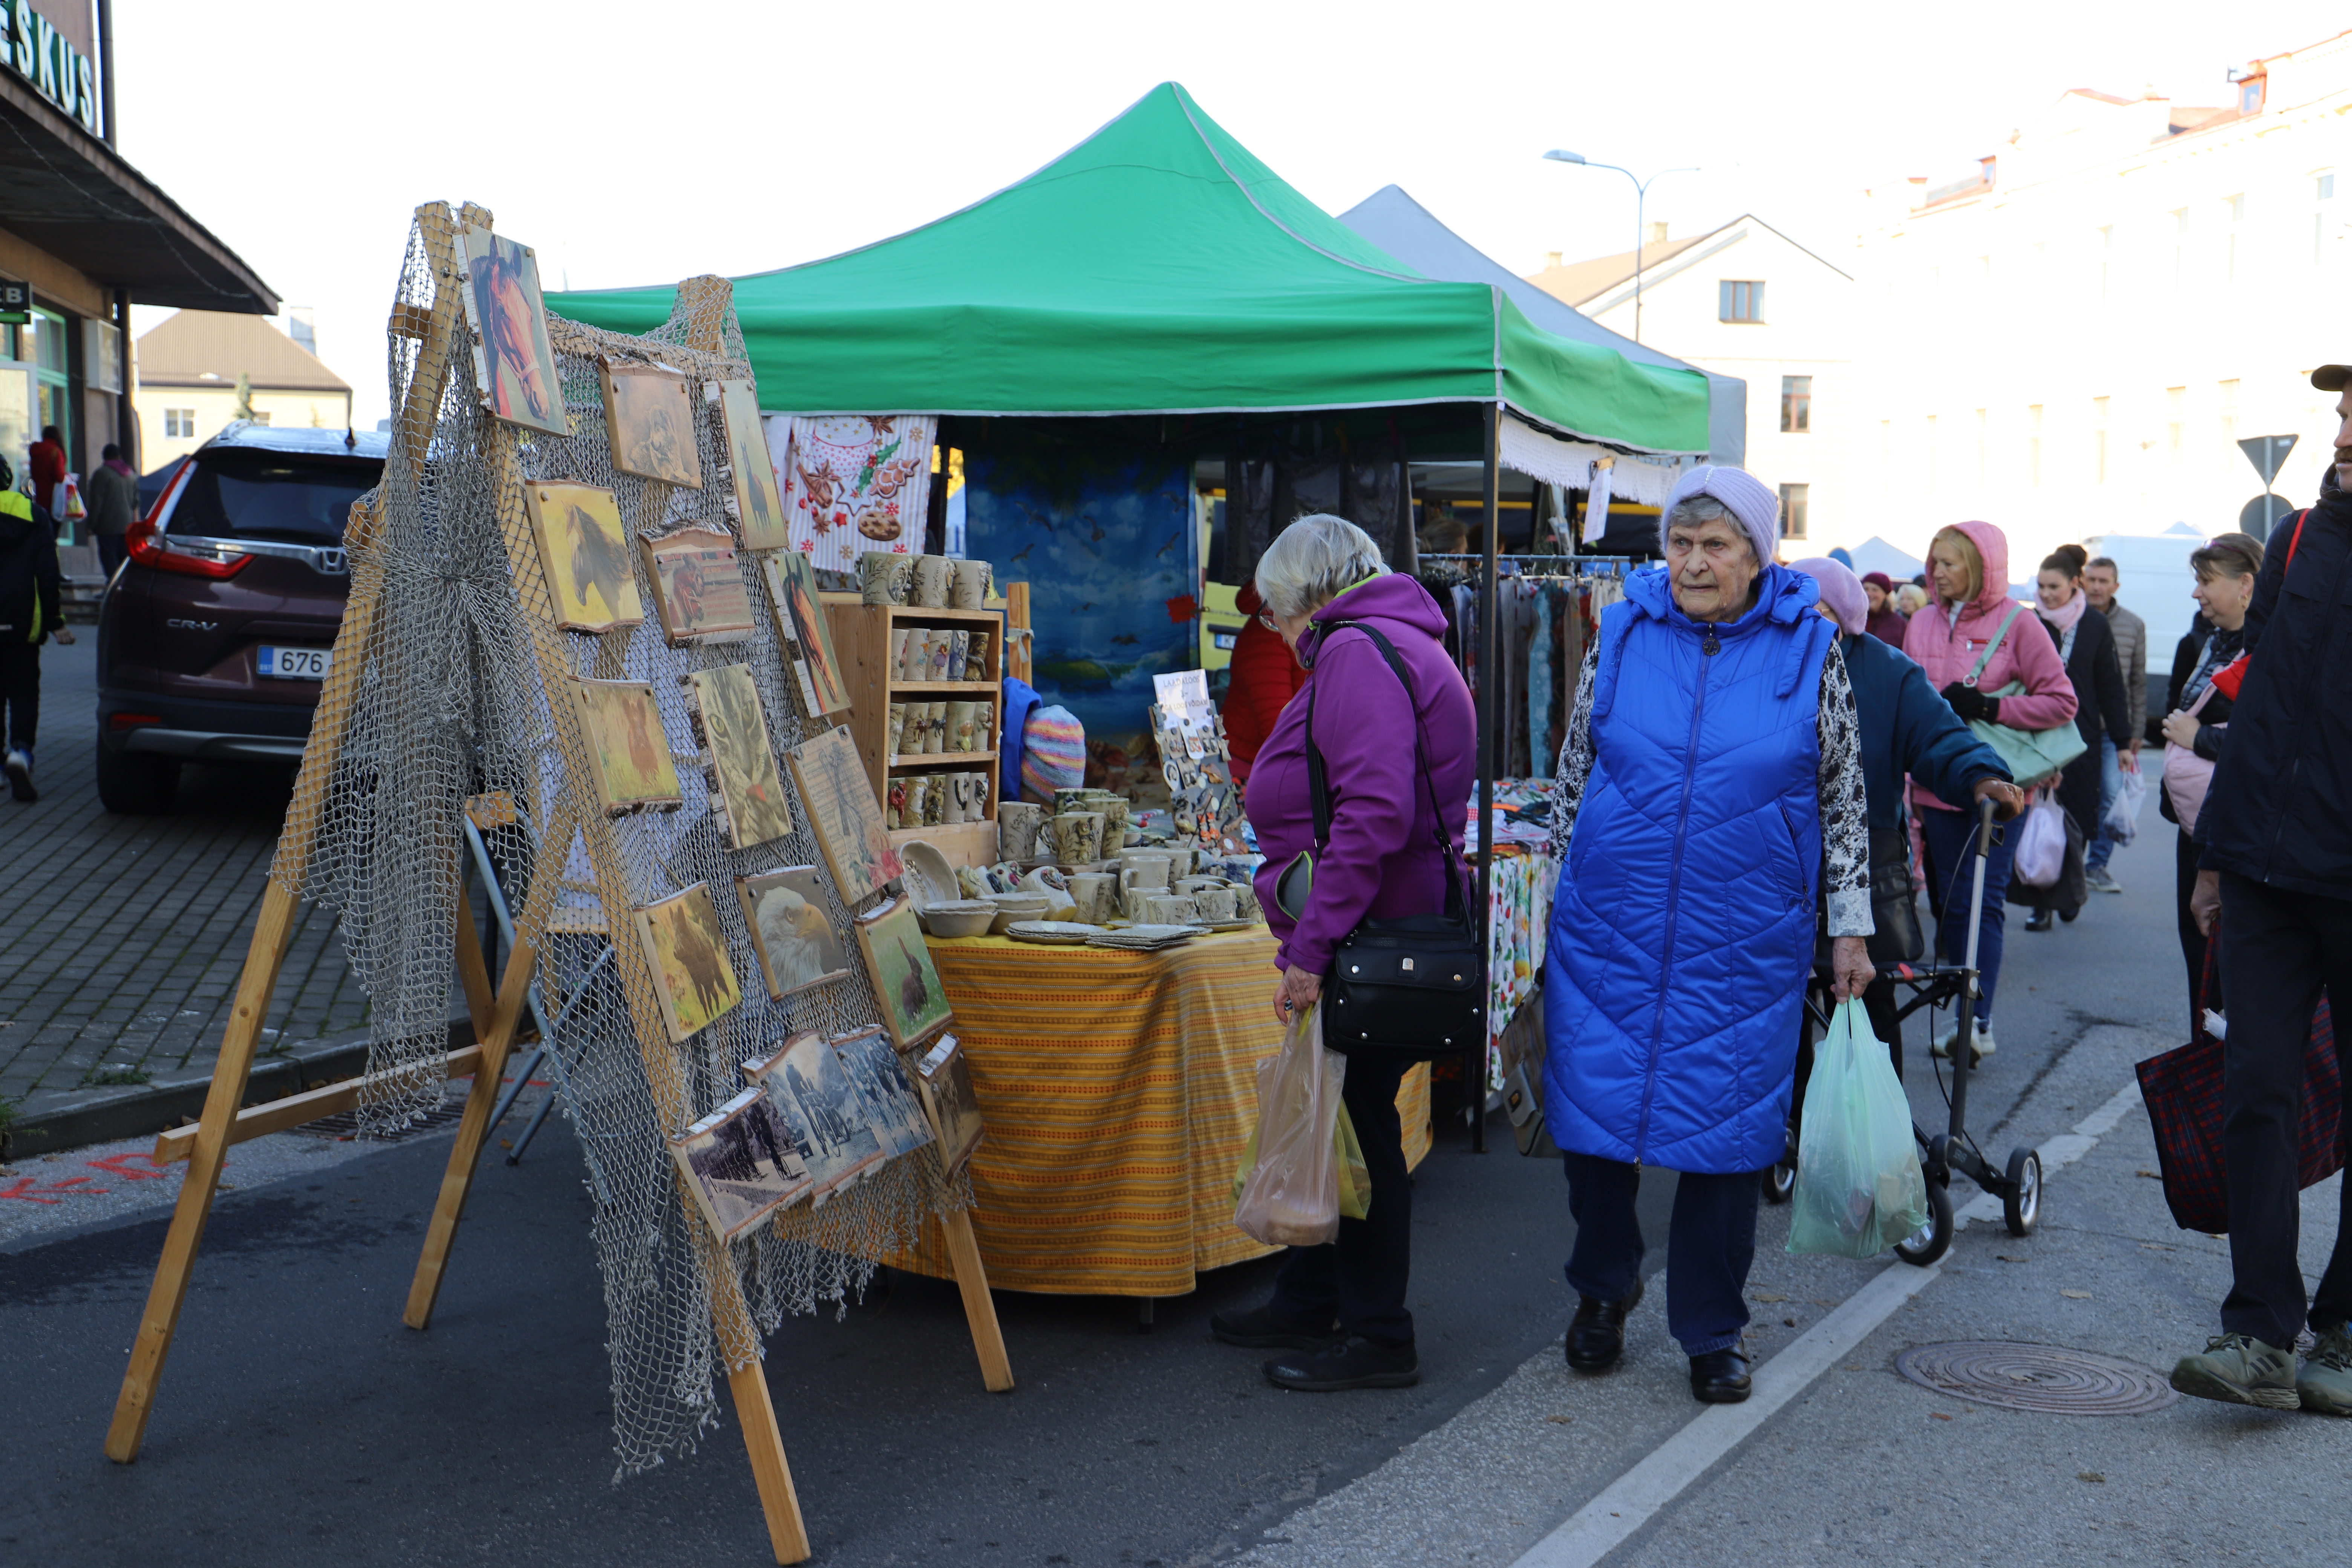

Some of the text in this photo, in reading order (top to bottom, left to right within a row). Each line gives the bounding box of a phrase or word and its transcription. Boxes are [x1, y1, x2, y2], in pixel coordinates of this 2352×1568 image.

[167, 619, 217, 631] CR-V
[282, 651, 323, 673] 676
[816, 735, 828, 744] FROM
